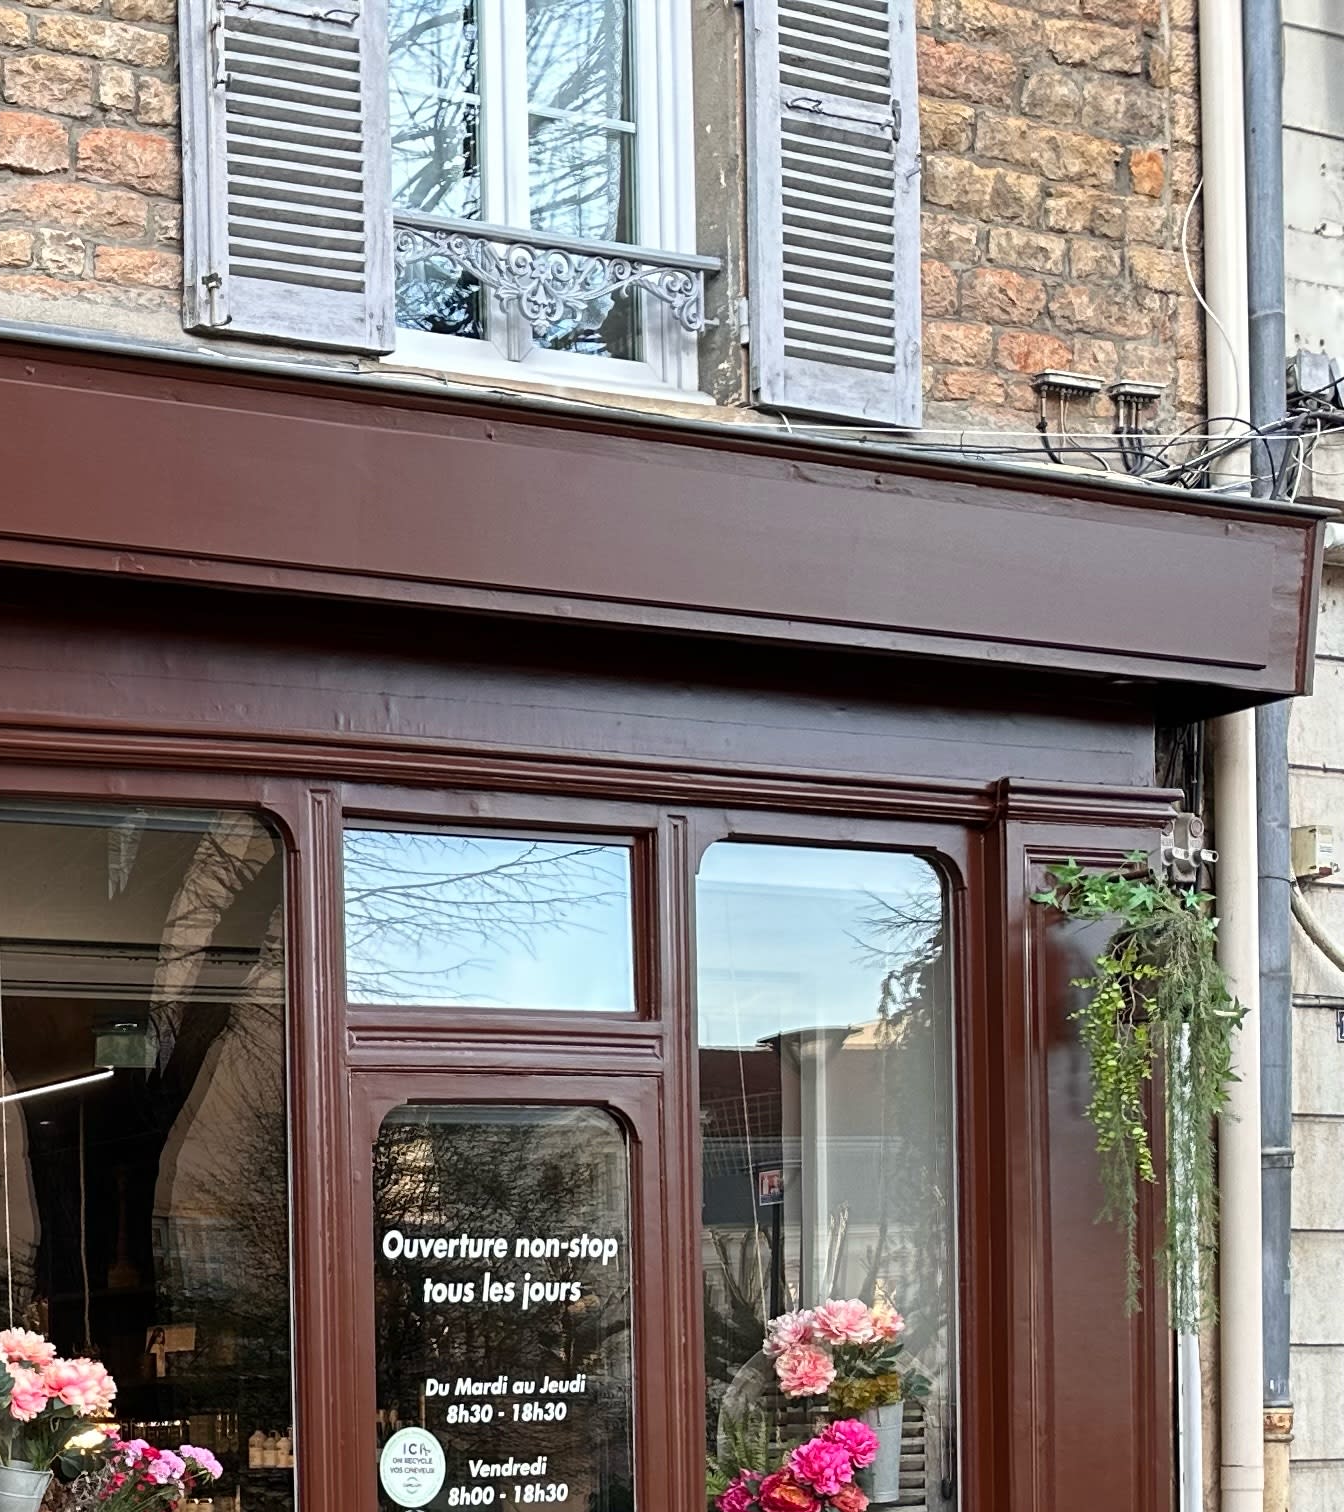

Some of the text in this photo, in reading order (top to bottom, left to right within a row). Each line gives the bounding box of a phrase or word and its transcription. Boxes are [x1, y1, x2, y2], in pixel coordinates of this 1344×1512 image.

[382, 1229, 619, 1266] Ouverture non-stop
[423, 1272, 582, 1311] tous les jours
[425, 1373, 586, 1397] Du Mardi au Jeudi
[445, 1404, 493, 1424] 8h30
[512, 1402, 568, 1422] 18h30
[403, 1443, 423, 1455] ICI
[468, 1456, 547, 1478] Vendredi
[447, 1486, 494, 1507] 8h00
[513, 1483, 569, 1504] 18h30
